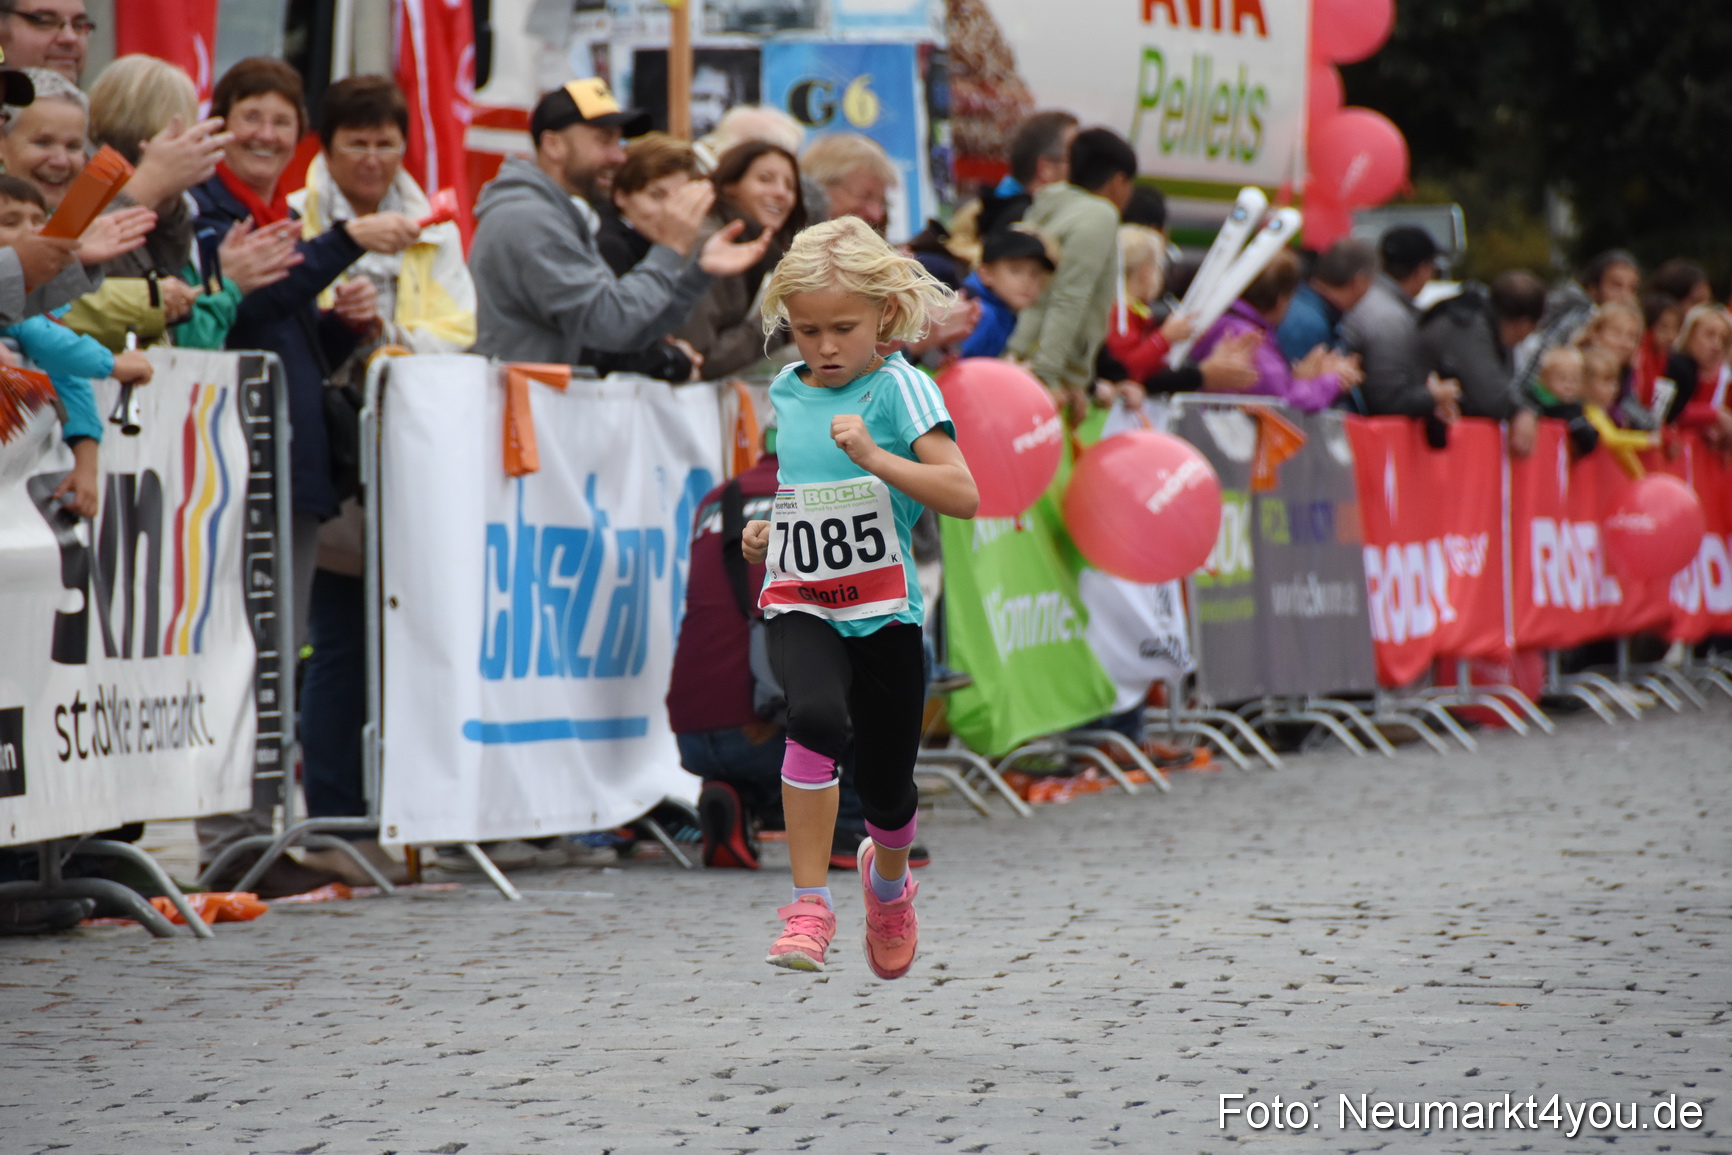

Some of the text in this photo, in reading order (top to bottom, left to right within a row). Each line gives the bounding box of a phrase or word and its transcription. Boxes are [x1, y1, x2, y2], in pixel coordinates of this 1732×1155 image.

[1128, 47, 1269, 163] Pellets
[803, 481, 876, 506] BOCK
[776, 511, 886, 574] 7085
[891, 553, 898, 564] K
[797, 584, 859, 604] Gloria
